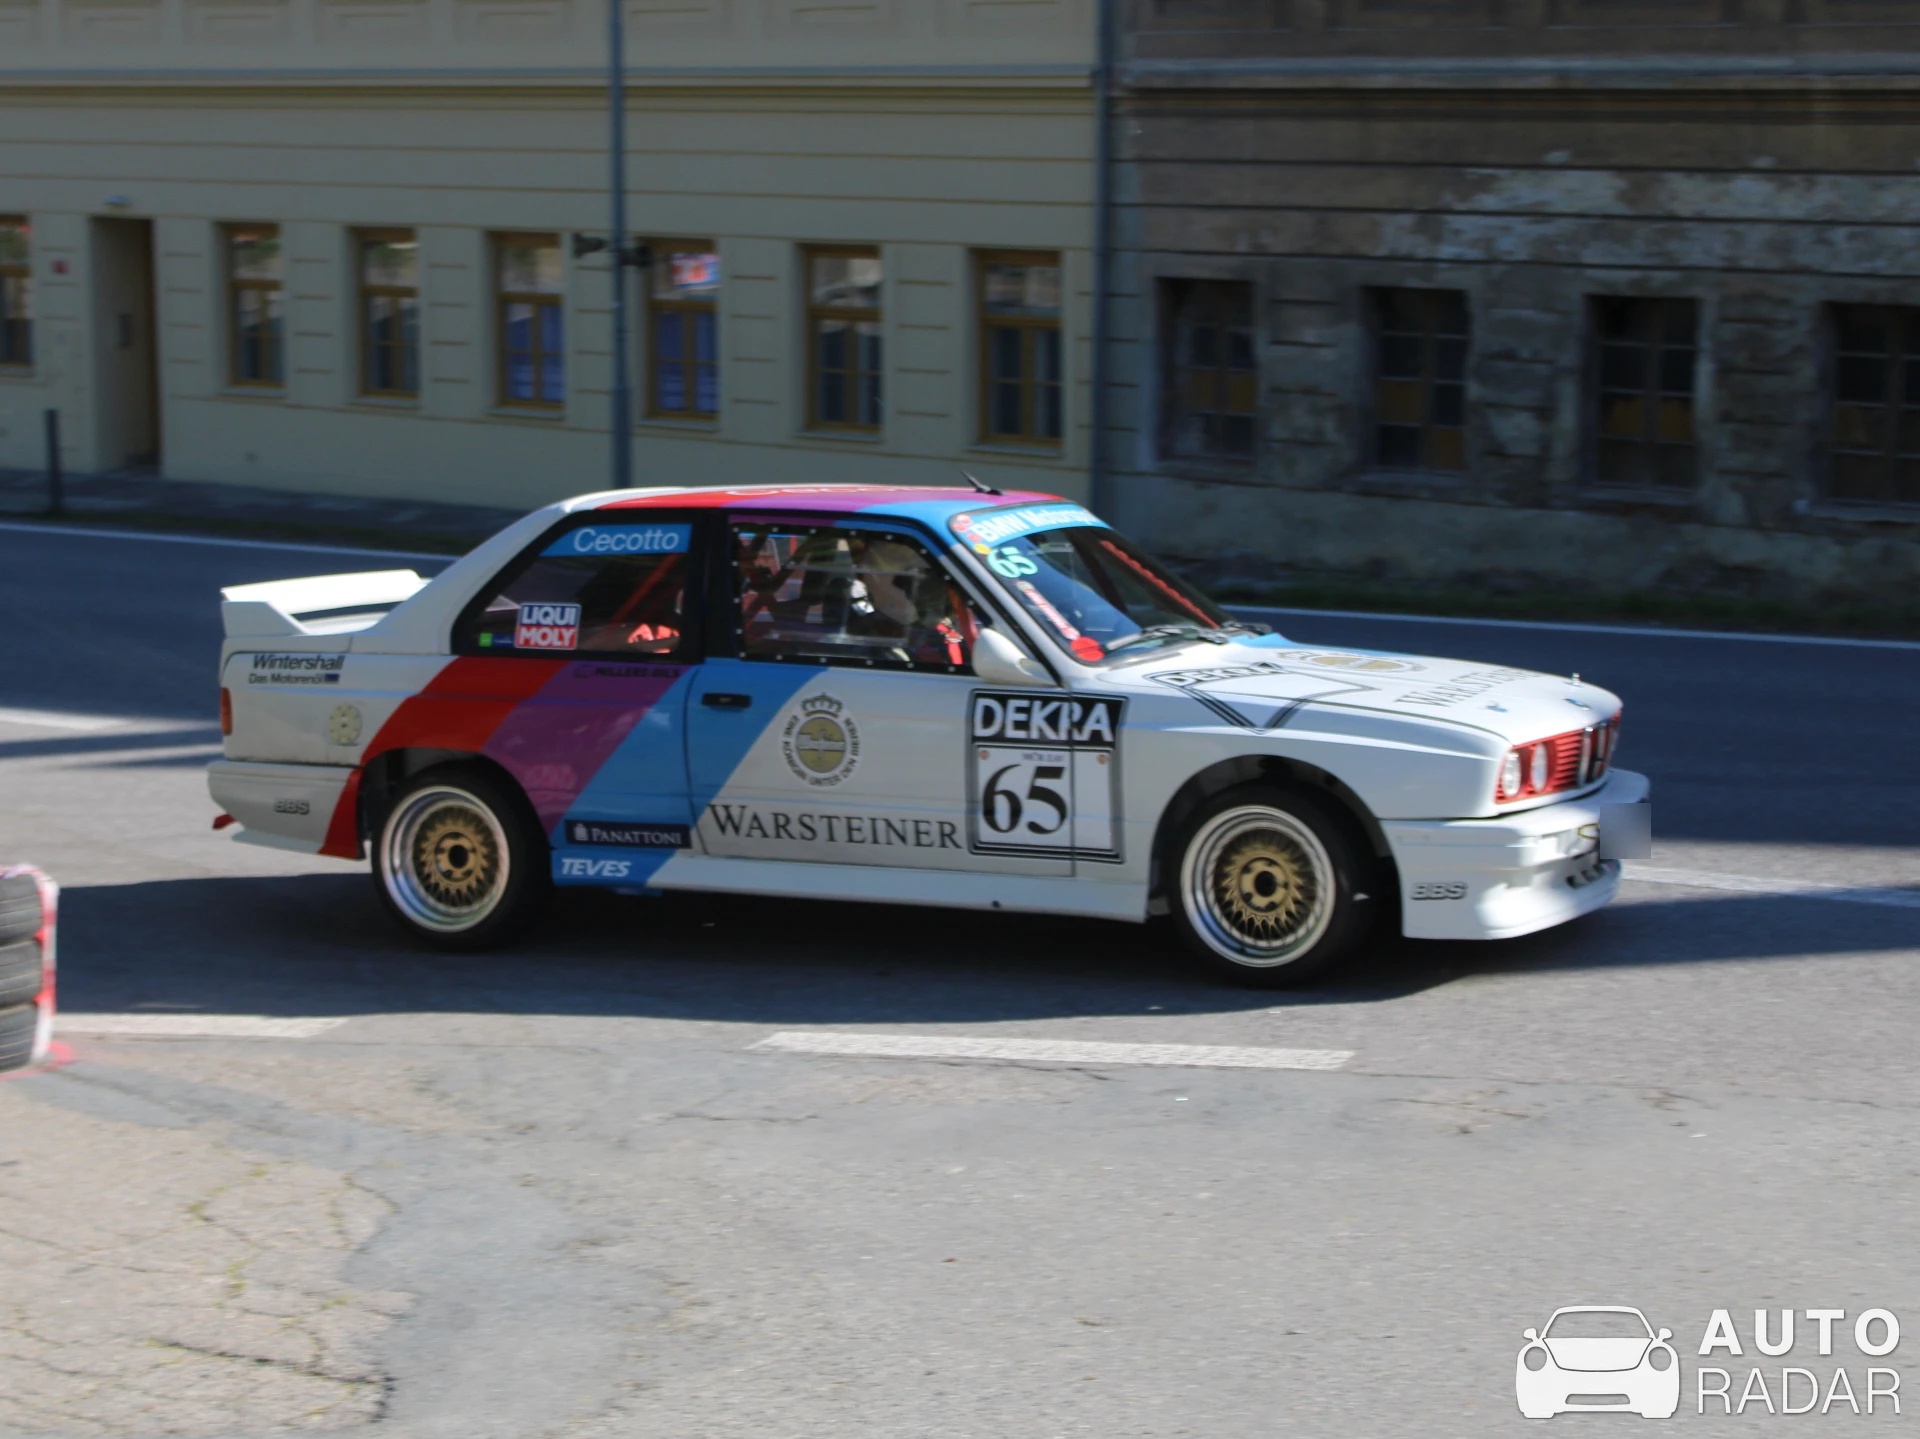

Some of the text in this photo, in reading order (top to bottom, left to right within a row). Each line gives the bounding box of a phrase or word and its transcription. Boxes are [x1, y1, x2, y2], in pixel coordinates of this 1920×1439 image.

[969, 512, 1030, 543] BMW
[573, 528, 679, 552] Cecotto
[987, 546, 1038, 578] 65
[521, 605, 577, 626] LIQUI
[518, 627, 576, 648] MOLY
[253, 654, 346, 671] Wintershall
[248, 673, 268, 684] Das
[1153, 661, 1283, 688] DEKRA
[973, 696, 1115, 742] DEKRA
[273, 799, 311, 816] BBS
[982, 763, 1068, 836] 65
[590, 827, 682, 845] PANATTONI
[707, 803, 965, 850] WARSTEINER
[561, 857, 632, 878] TEVES
[1410, 882, 1469, 901] BBS
